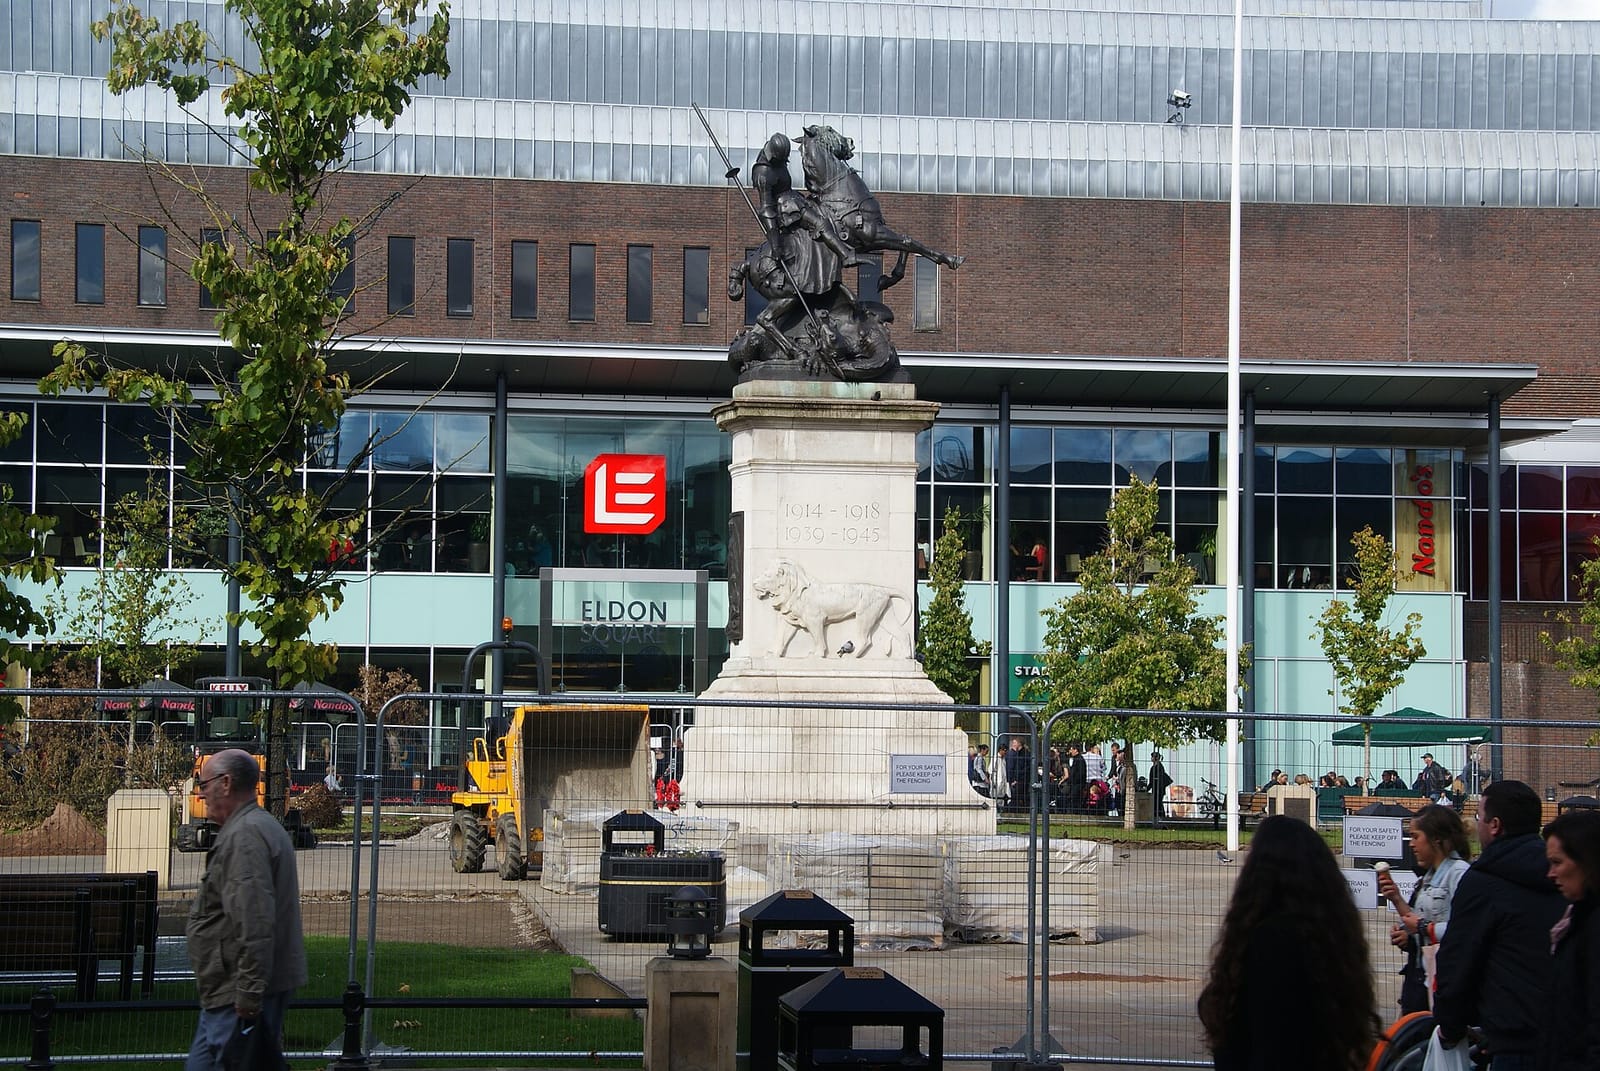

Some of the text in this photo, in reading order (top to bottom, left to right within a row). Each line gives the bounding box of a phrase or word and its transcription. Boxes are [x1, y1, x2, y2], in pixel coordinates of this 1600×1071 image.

[785, 503, 823, 521] 1914
[845, 502, 880, 521] 1918
[1410, 465, 1435, 578] Nando's
[785, 527, 824, 544] 1939
[842, 527, 880, 544] 1945
[582, 600, 667, 622] ELDON
[581, 623, 666, 648] SQUARE
